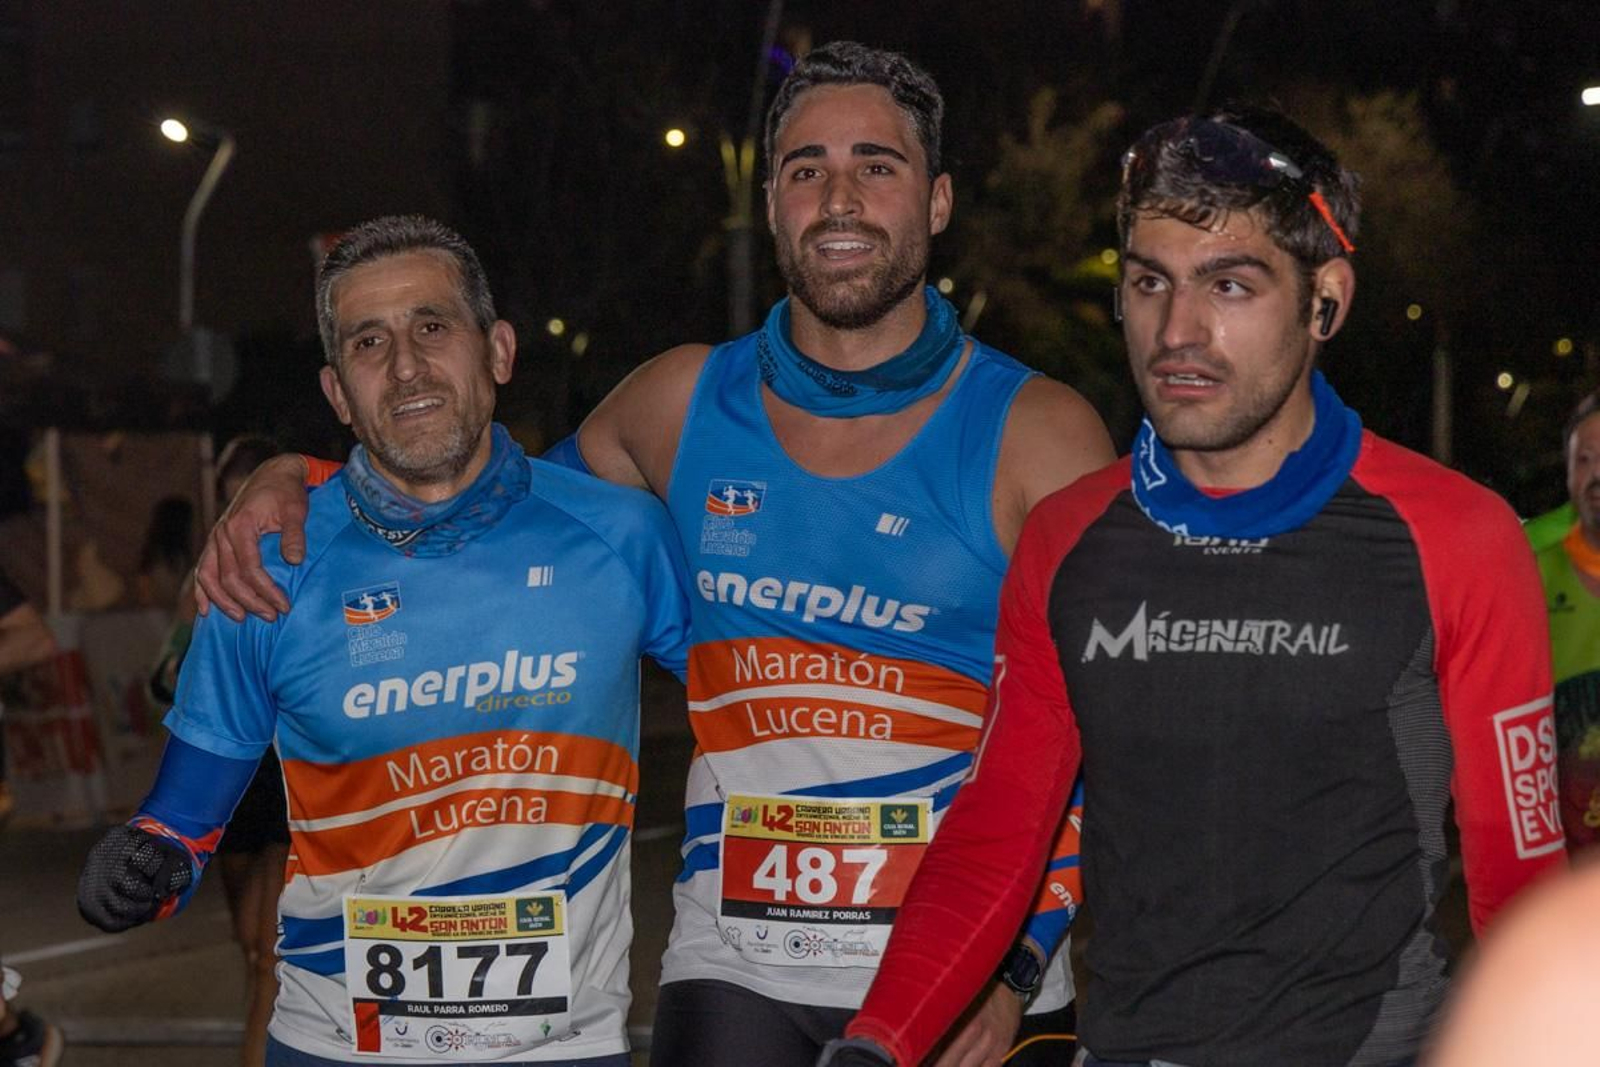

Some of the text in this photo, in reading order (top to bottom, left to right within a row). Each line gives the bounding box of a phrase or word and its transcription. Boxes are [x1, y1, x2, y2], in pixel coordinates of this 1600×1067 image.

[697, 570, 931, 633] enerplus
[343, 650, 578, 719] enerplus
[732, 645, 904, 692] Maratón
[476, 689, 571, 714] directo
[746, 702, 892, 740] Lucena
[386, 734, 559, 792] Maratón
[410, 795, 548, 839] Lucena
[762, 804, 794, 833] 42
[795, 821, 820, 833] SAN
[1520, 801, 1563, 842] EV
[753, 845, 888, 905] 487
[391, 906, 429, 933] 42
[429, 920, 458, 933] SAN
[766, 907, 871, 920] JUAN RAMIREZ PORRAS
[366, 941, 549, 998] 8177
[407, 1003, 509, 1015] RAUL PARRA ROMERO
